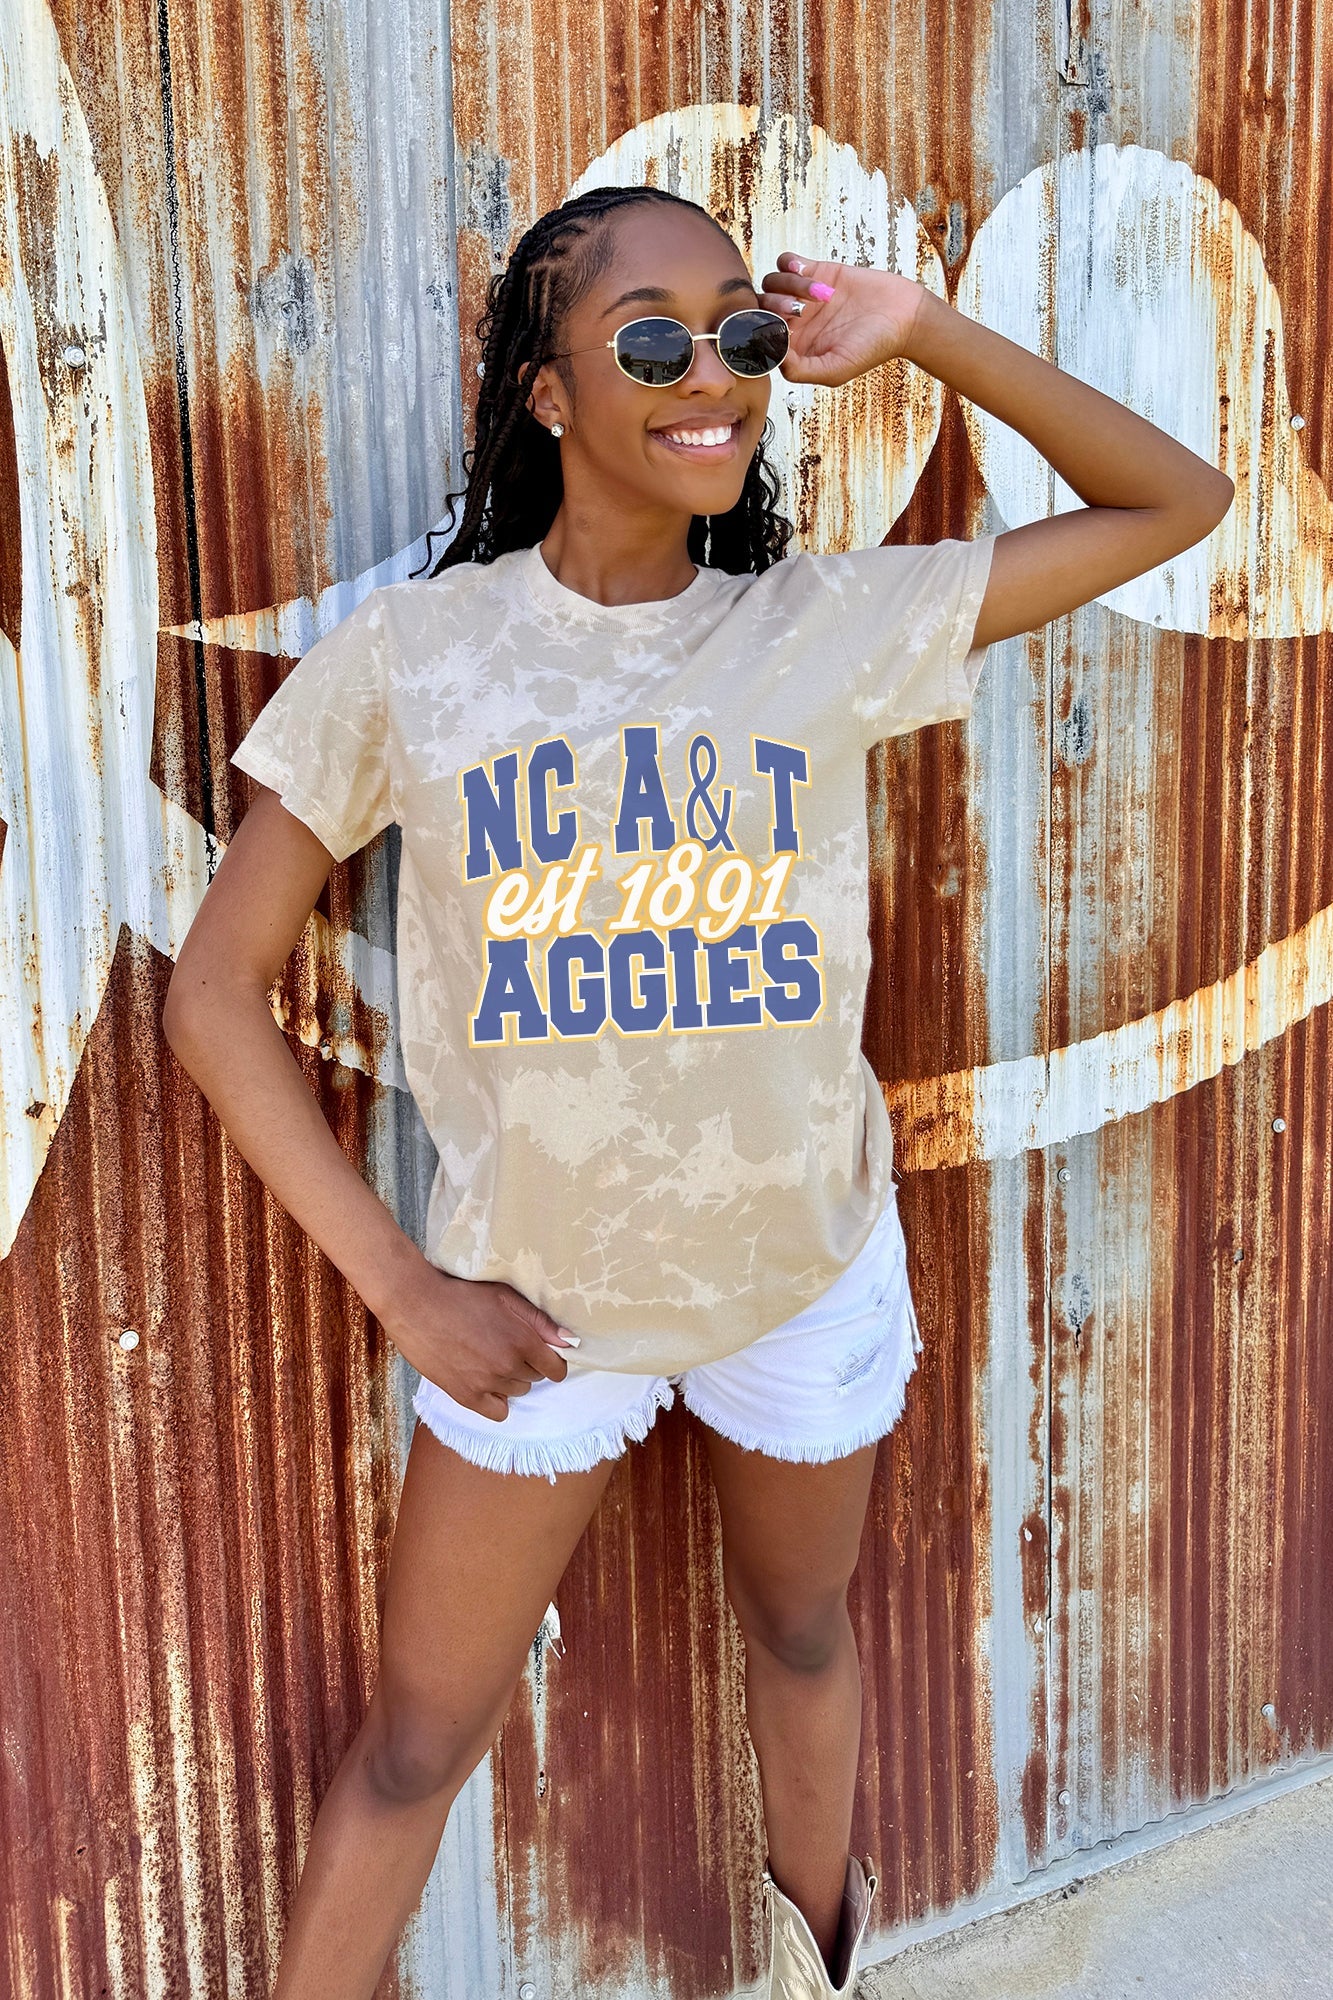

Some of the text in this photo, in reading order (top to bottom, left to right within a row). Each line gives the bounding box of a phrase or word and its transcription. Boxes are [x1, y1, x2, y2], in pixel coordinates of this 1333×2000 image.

[460, 735, 582, 884] NC
[485, 838, 797, 943] est 1891
[468, 918, 827, 1048] AGGIES
